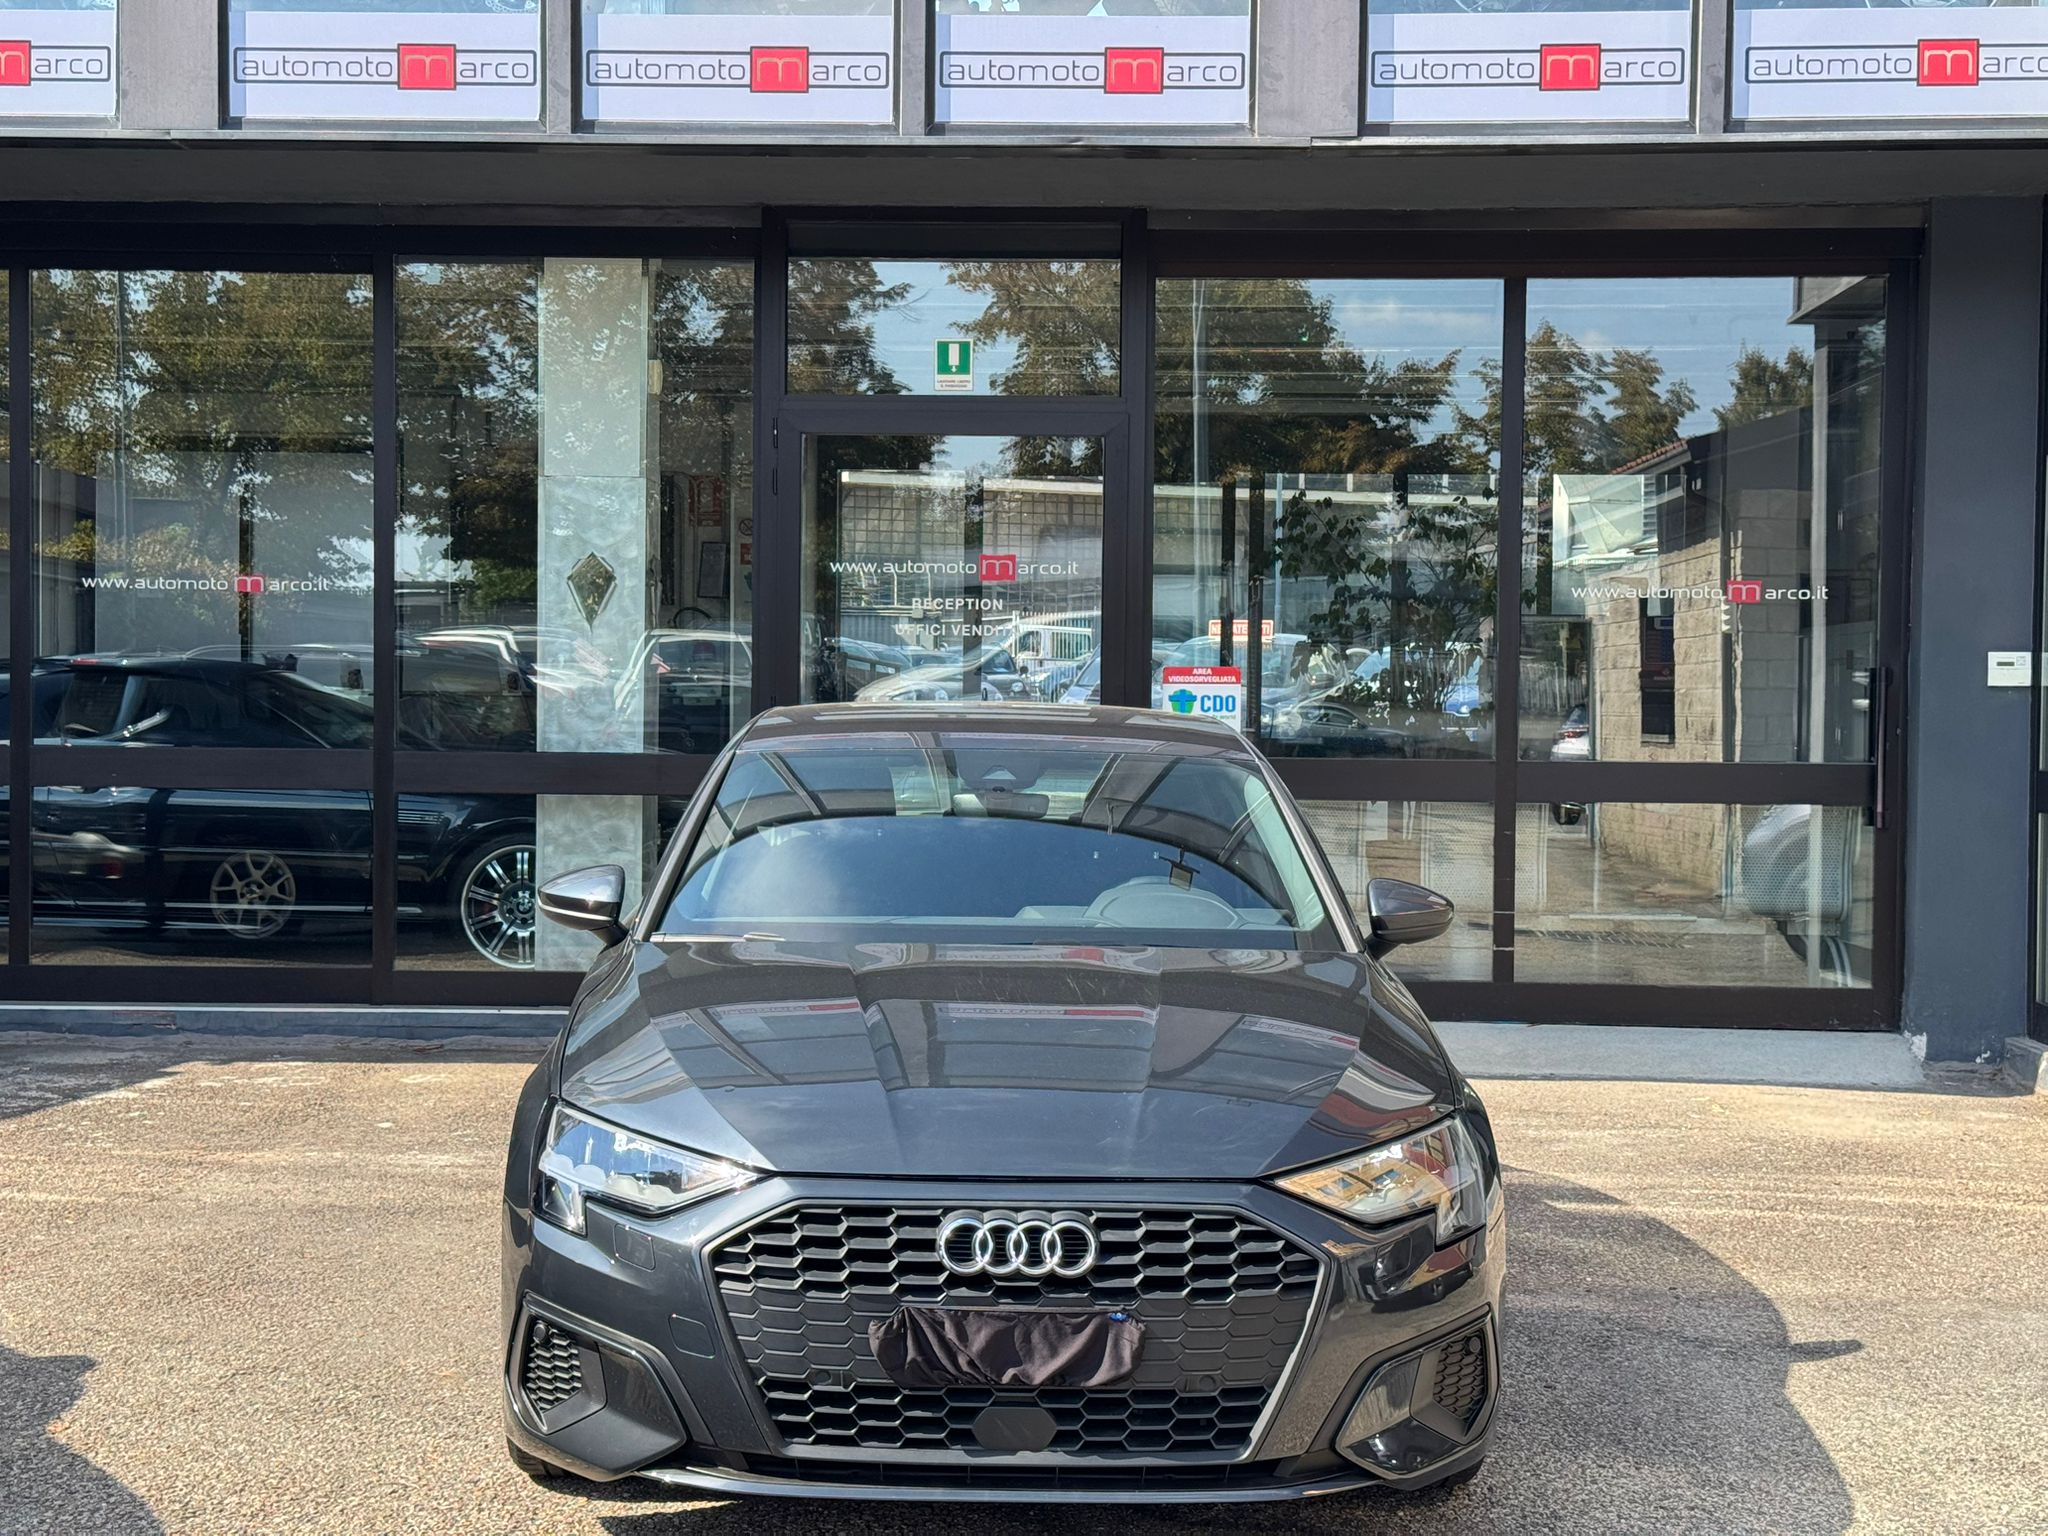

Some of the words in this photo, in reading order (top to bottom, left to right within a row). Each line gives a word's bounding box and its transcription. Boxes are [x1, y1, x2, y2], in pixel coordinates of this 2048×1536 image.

[911, 598, 1004, 611] RECEPTION
[895, 623, 946, 636] UFFICI
[1168, 675, 1237, 683] VIDEOSORVEGLIATA
[1200, 694, 1237, 713] CDO
